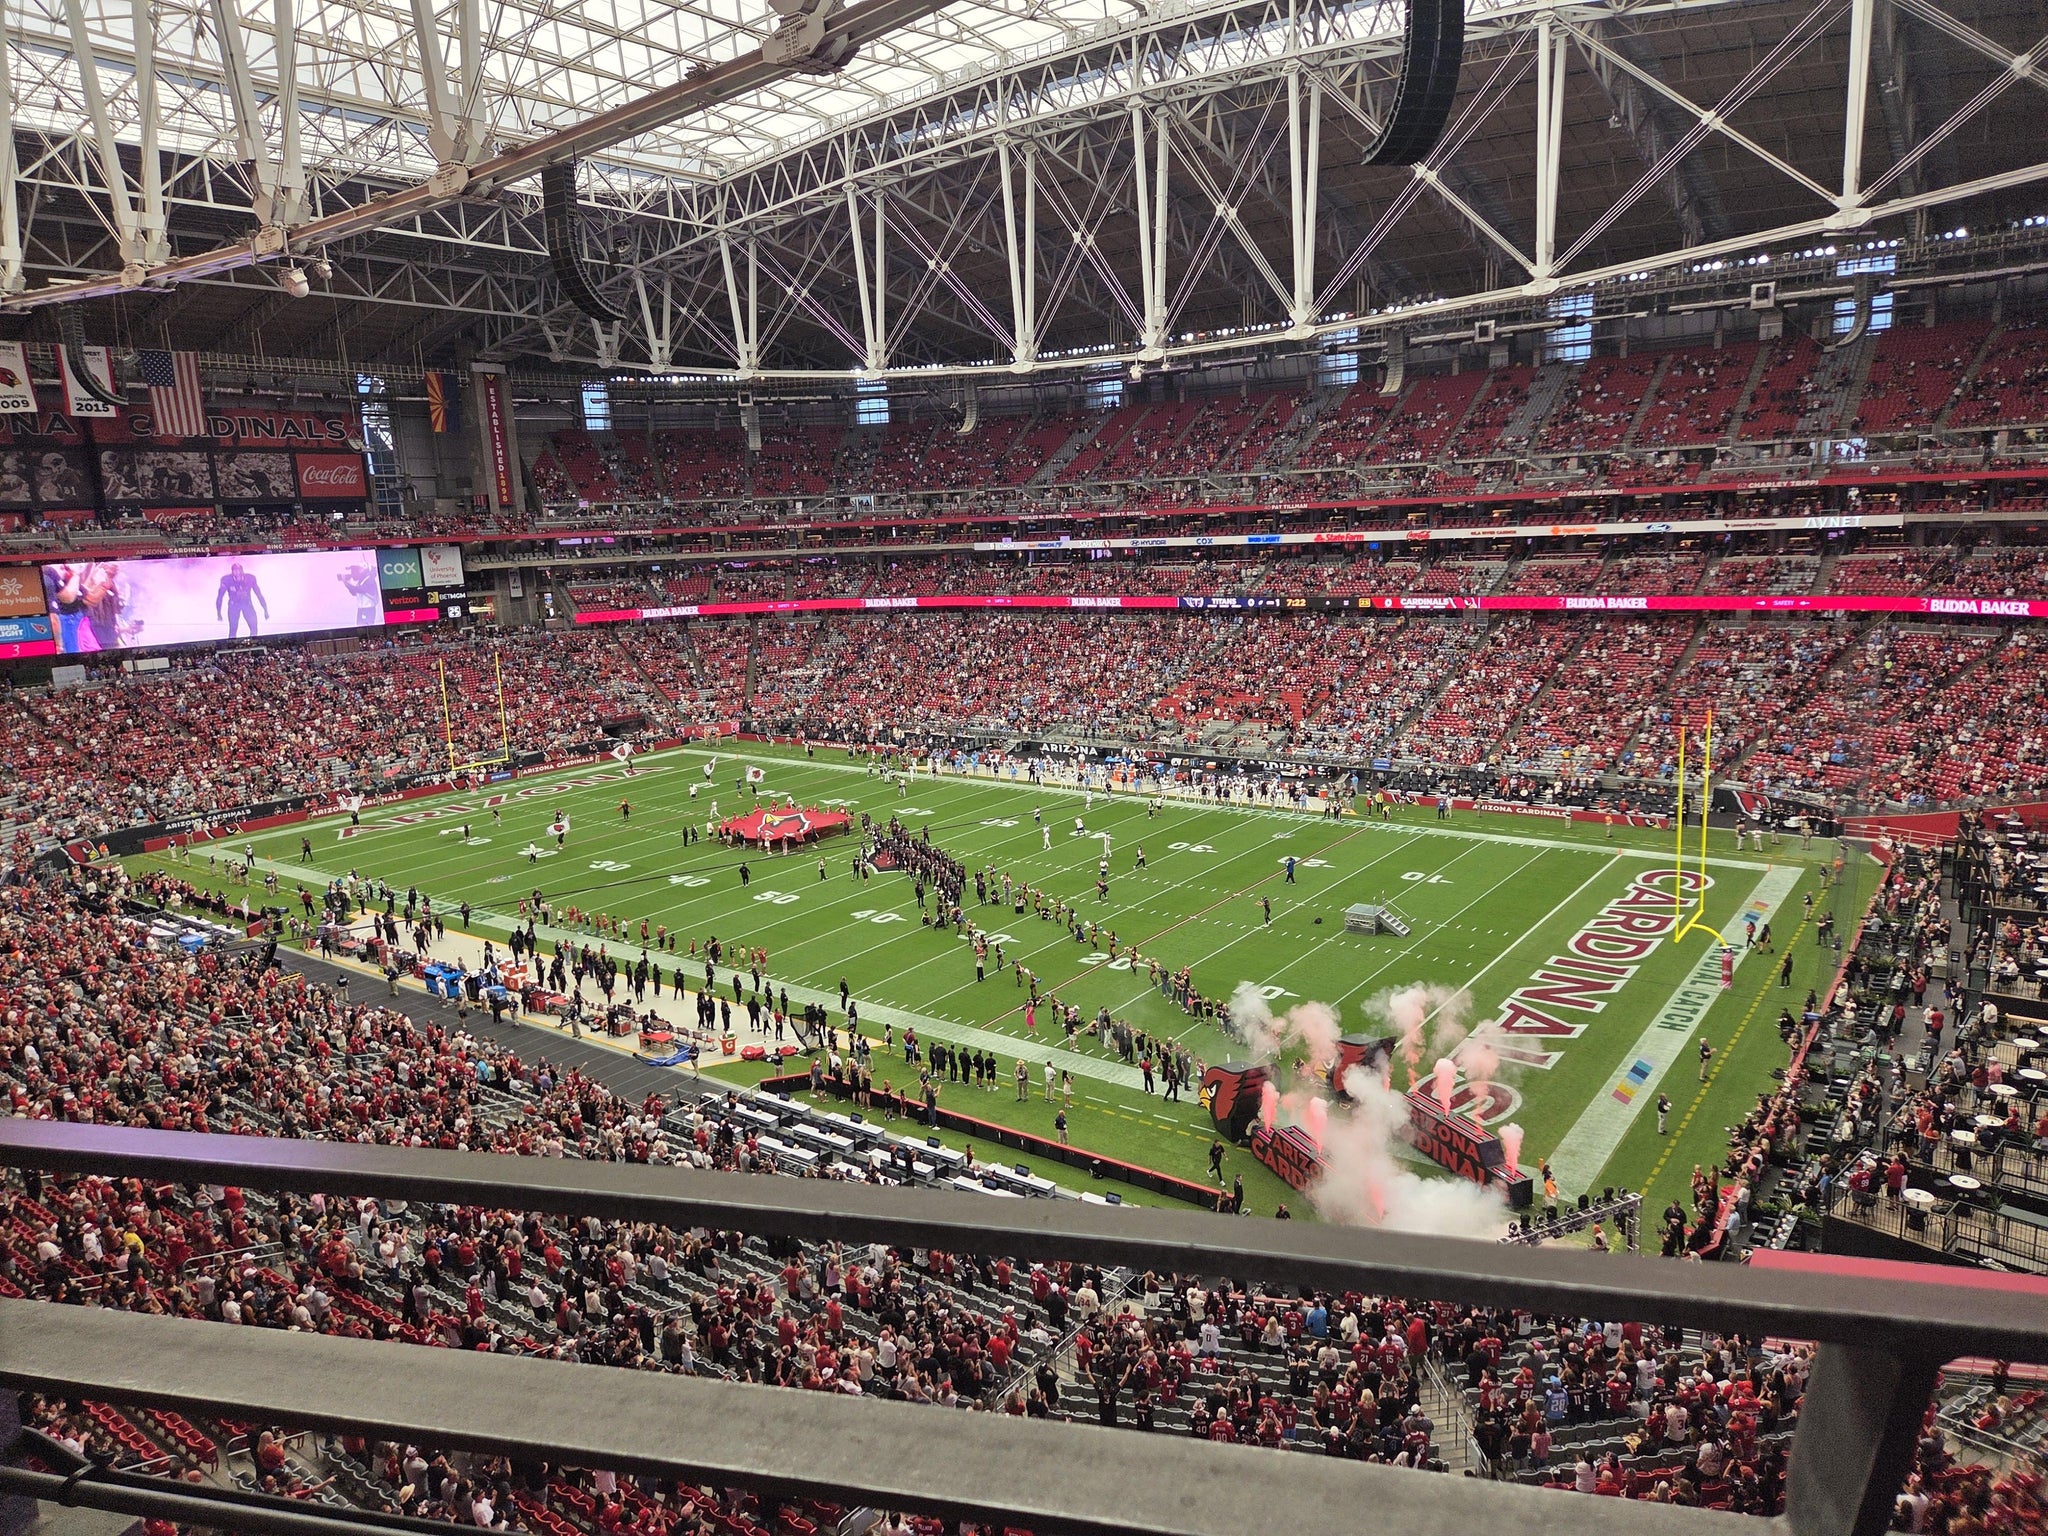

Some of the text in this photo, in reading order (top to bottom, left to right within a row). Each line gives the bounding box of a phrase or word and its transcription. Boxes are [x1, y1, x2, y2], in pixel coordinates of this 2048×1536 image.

[76, 402, 110, 412] 2015
[129, 414, 347, 441] CDINALS
[489, 387, 508, 502] ESTABLISHED 1898
[1803, 517, 1862, 528] AVNET
[383, 562, 416, 575] COX
[15, 596, 41, 604] Health
[389, 596, 420, 605] verizon
[439, 592, 466, 600] BETMGM
[1071, 597, 1096, 606] BUDDA
[1097, 597, 1122, 606] BAKER
[1401, 597, 1449, 606] CARDINALS
[865, 598, 891, 607] BUDDA
[892, 597, 918, 606] BAKER
[1566, 597, 1605, 609] BUDDA
[1607, 597, 1647, 609] BAKER
[1920, 598, 2029, 616] 3 BUDDA BAKER
[410, 611, 416, 620] 3
[642, 608, 670, 618] BUDDA
[672, 606, 700, 616] BAKER
[12, 645, 20, 657] 3
[523, 756, 594, 774] ARIZONA CARDINALS
[668, 874, 711, 888] 40
[753, 890, 800, 905] 50
[850, 909, 900, 924] 40
[1656, 990, 1710, 1032] CATCH
[725, 1040, 733, 1049] G
[1273, 1133, 1322, 1179] ARIZO
[1361, 1353, 1369, 1362] 21
[1520, 1390, 1533, 1399] 81
[1551, 1400, 1565, 1412] 28
[1196, 1424, 1207, 1434] 40
[1677, 1420, 1684, 1430] 3
